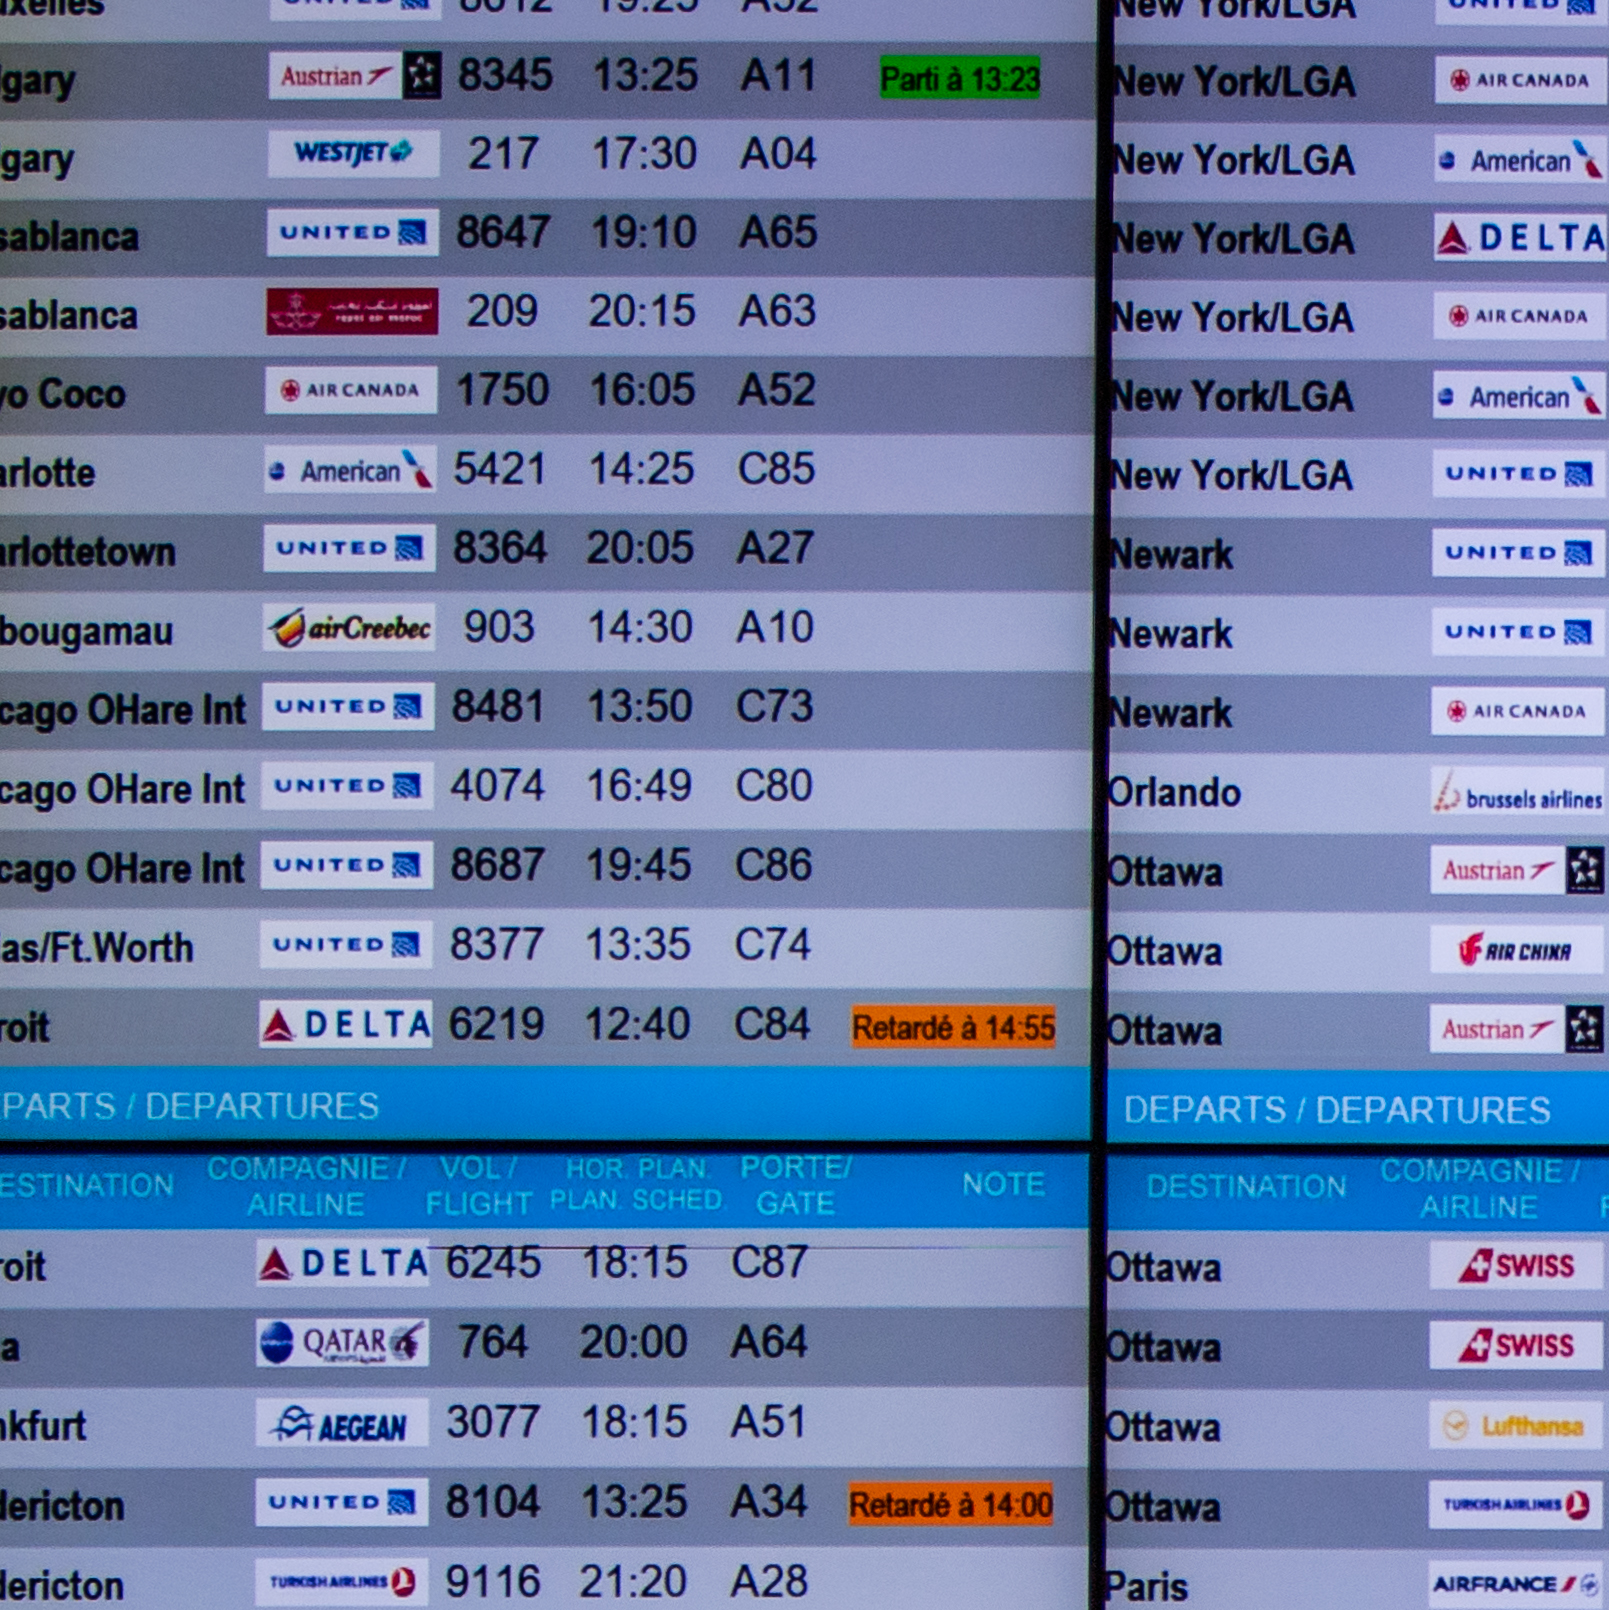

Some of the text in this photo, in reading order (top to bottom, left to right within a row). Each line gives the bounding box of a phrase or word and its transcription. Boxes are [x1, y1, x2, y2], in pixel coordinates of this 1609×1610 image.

[281, 66, 363, 86] Austrian
[459, 57, 553, 91] 8345
[595, 57, 698, 91] 13:25
[741, 57, 813, 91] A11
[882, 65, 1040, 94] Parti à 13:23
[295, 142, 389, 168] WESTJET
[470, 136, 539, 169] 217
[595, 136, 697, 169] 17:30
[741, 136, 817, 169] A04
[1114, 143, 1355, 177] New York/LGA
[1471, 149, 1571, 172] American
[88, 693, 246, 725] OHare Int
[276, 700, 386, 713] UNITED
[453, 688, 541, 722] 8481
[589, 688, 692, 722] 13:50
[737, 688, 813, 722] C73
[1109, 934, 1223, 967] Ottawa
[1486, 943, 1572, 961] AIR CHINA
[307, 1010, 431, 1038] DELTA
[450, 1006, 544, 1040] 6219
[587, 1006, 690, 1040] 12:40
[735, 1006, 811, 1040] C84
[853, 1015, 1055, 1045] Retardé à 14:55
[147, 1092, 380, 1120] DEPARTURES
[1125, 1095, 1286, 1123] DEPARTS
[1317, 1096, 1551, 1125] DEPARTURES
[1148, 1173, 1346, 1198] DESTINATION
[1382, 1159, 1561, 1187] COMPAGNIE
[1420, 1194, 1538, 1219] AIRLINE
[319, 1415, 407, 1441] AEGEAN
[448, 1404, 541, 1438] 3077
[584, 1404, 687, 1438] 18:15
[731, 1404, 803, 1438] A51
[1107, 1570, 1189, 1601] Paris
[1434, 1576, 1557, 1592] AIRFRANCE
